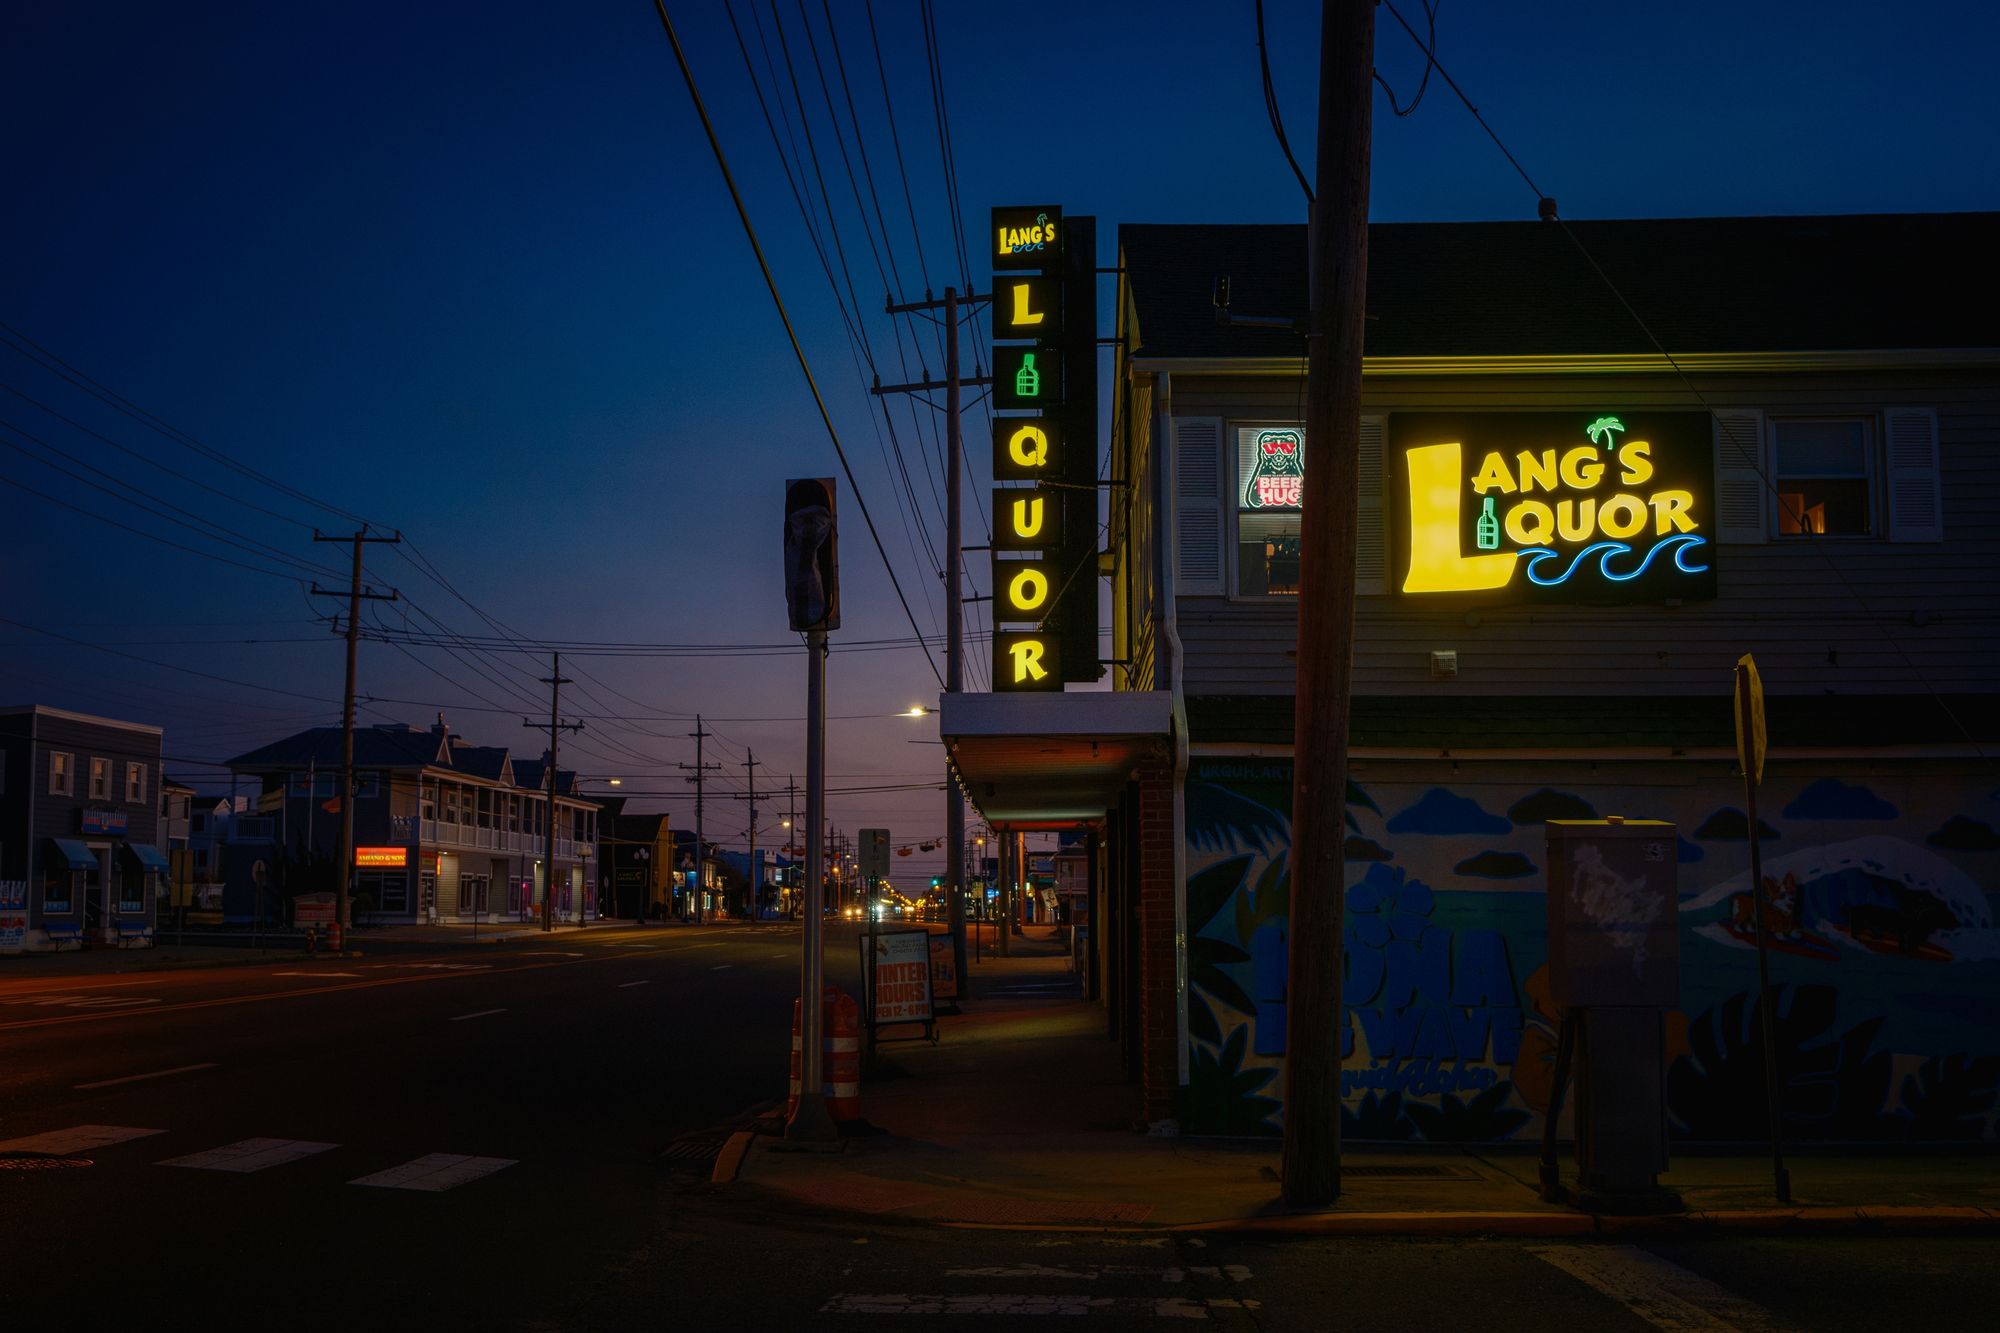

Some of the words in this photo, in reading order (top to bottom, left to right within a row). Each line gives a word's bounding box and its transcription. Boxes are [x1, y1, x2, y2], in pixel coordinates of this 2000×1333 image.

[1260, 477, 1302, 488] BEER
[1260, 488, 1301, 503] HUG
[876, 1006, 892, 1018] PEN
[893, 1005, 903, 1017] 12
